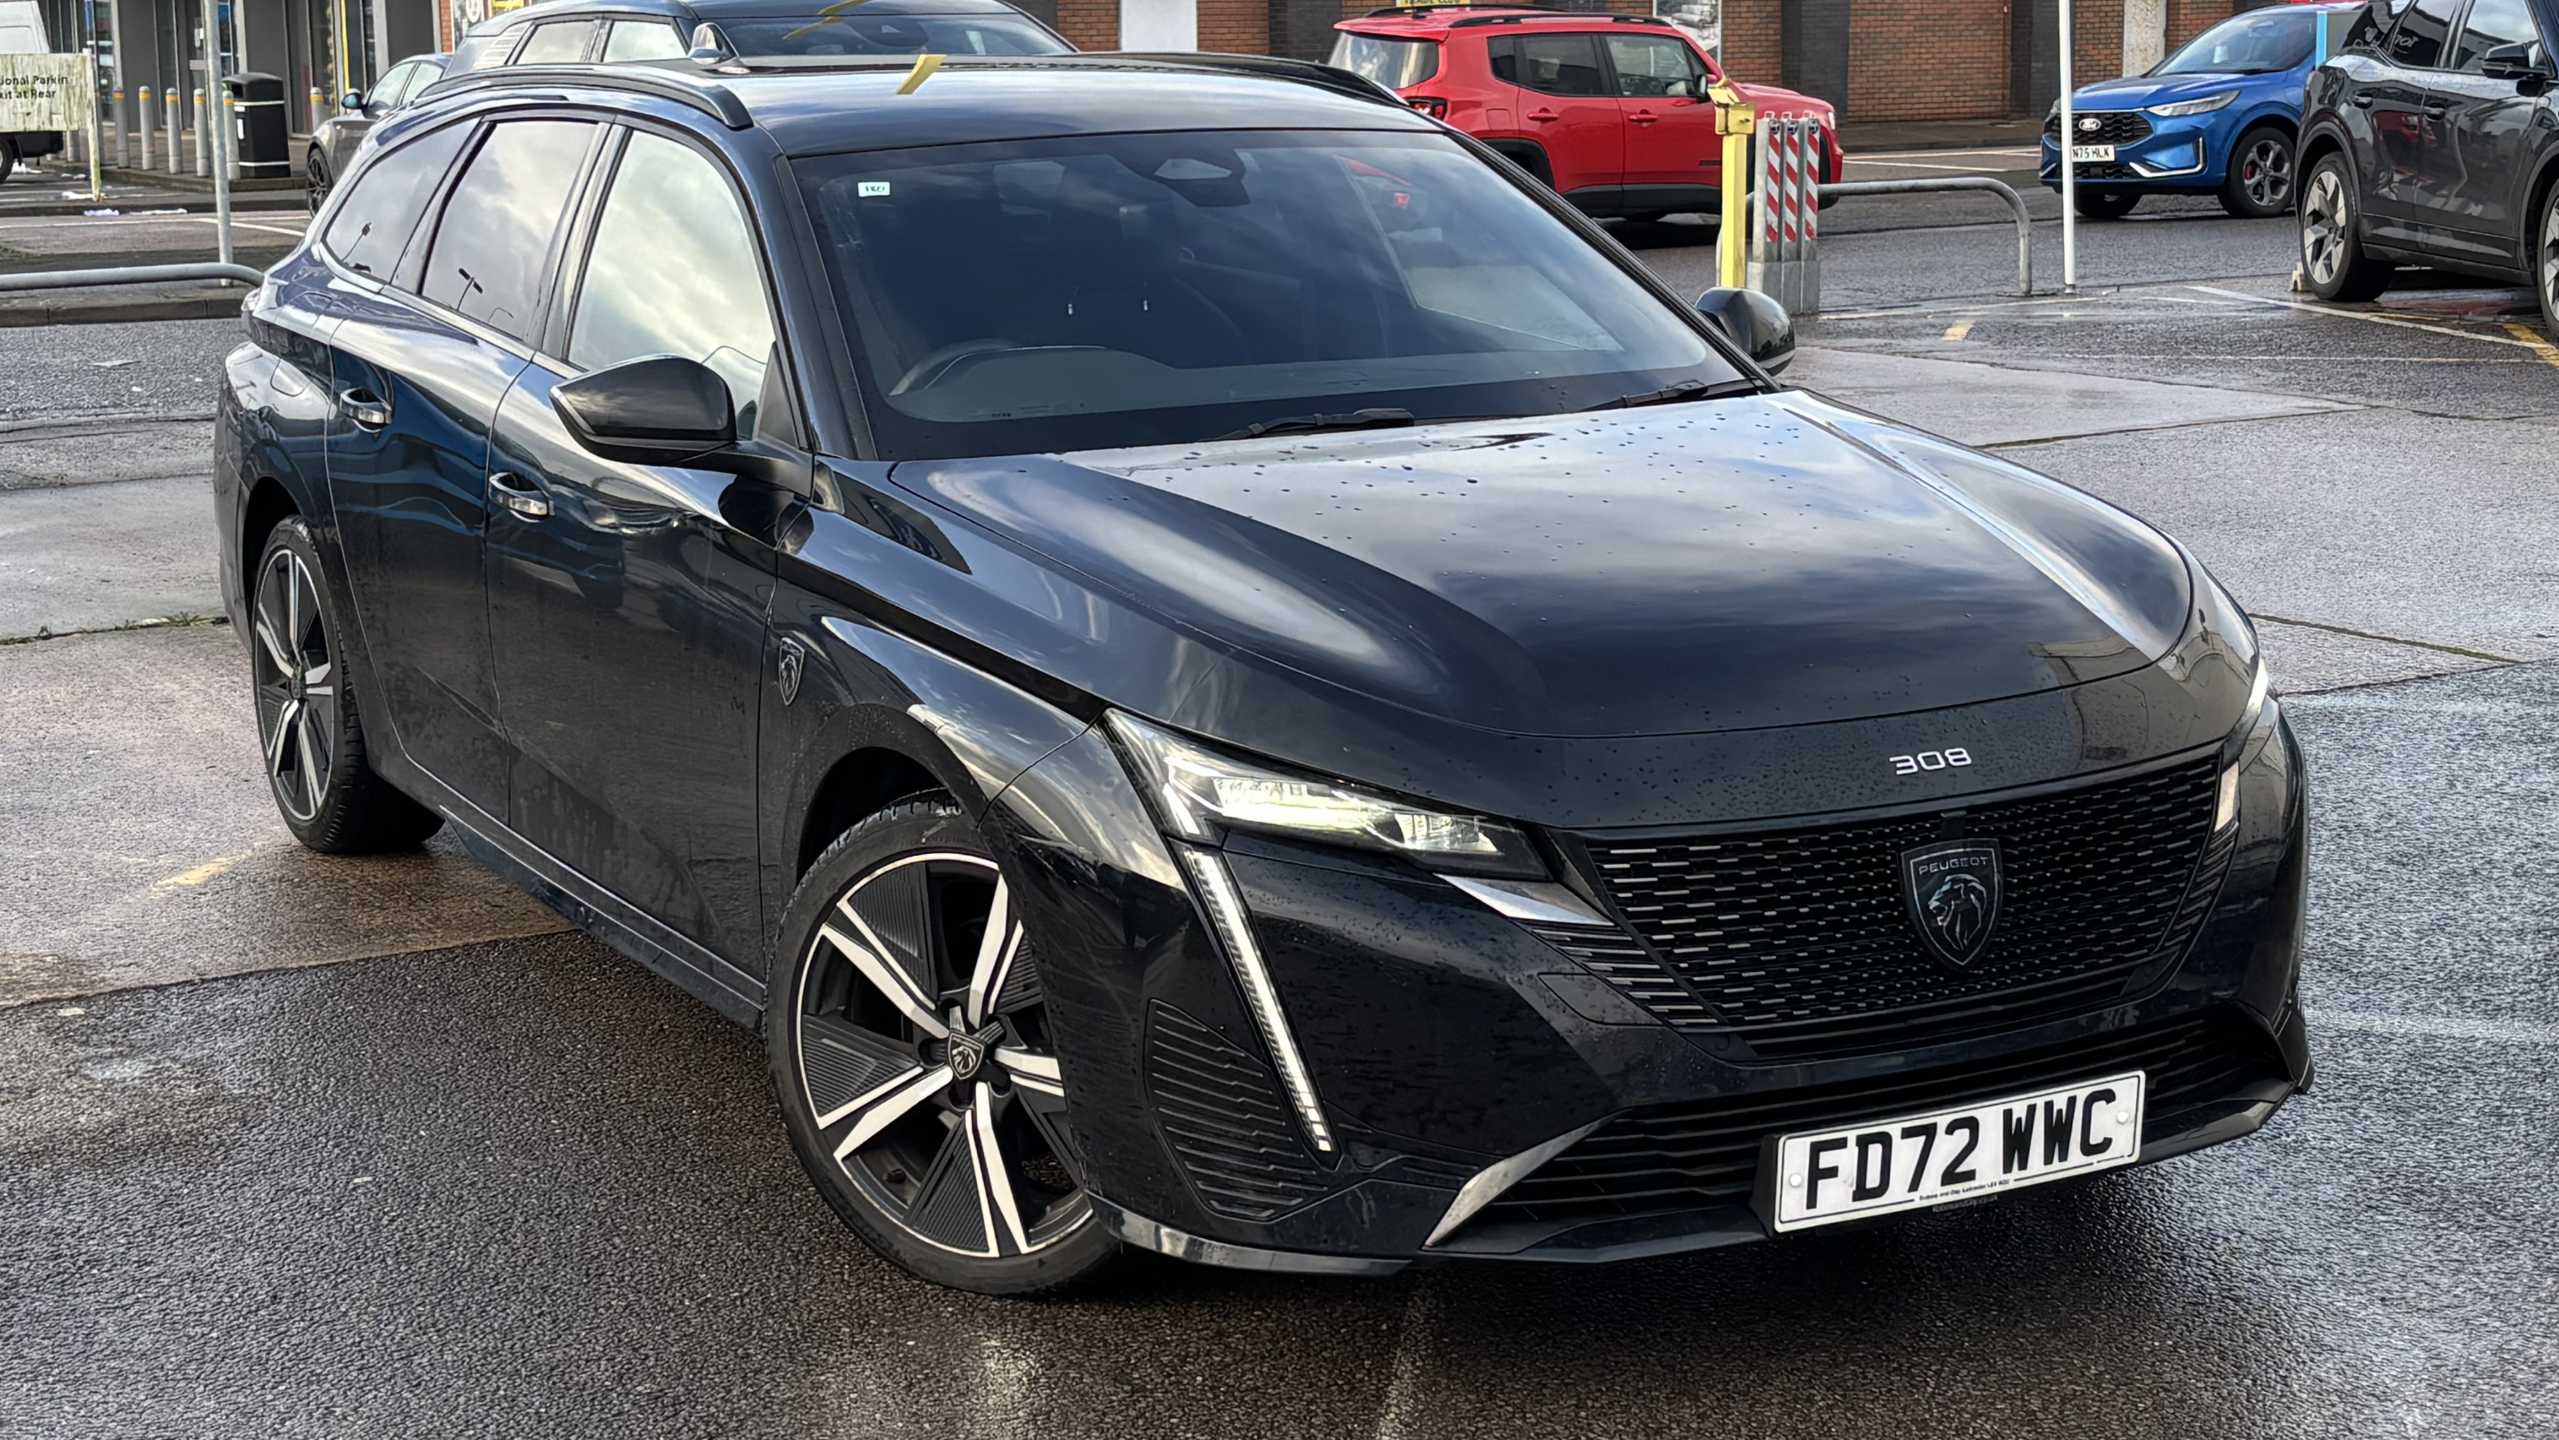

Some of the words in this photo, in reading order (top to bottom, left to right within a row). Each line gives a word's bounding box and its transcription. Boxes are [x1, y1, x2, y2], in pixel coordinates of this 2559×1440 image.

[0, 75, 29, 86] ional
[33, 75, 72, 86] Parkin
[31, 89, 56, 99] Rear
[1889, 747, 1972, 775] 308
[1919, 857, 1989, 875] PEUGEOT
[1805, 1115, 1980, 1210] FD72
[2002, 1088, 2117, 1175] WWC
